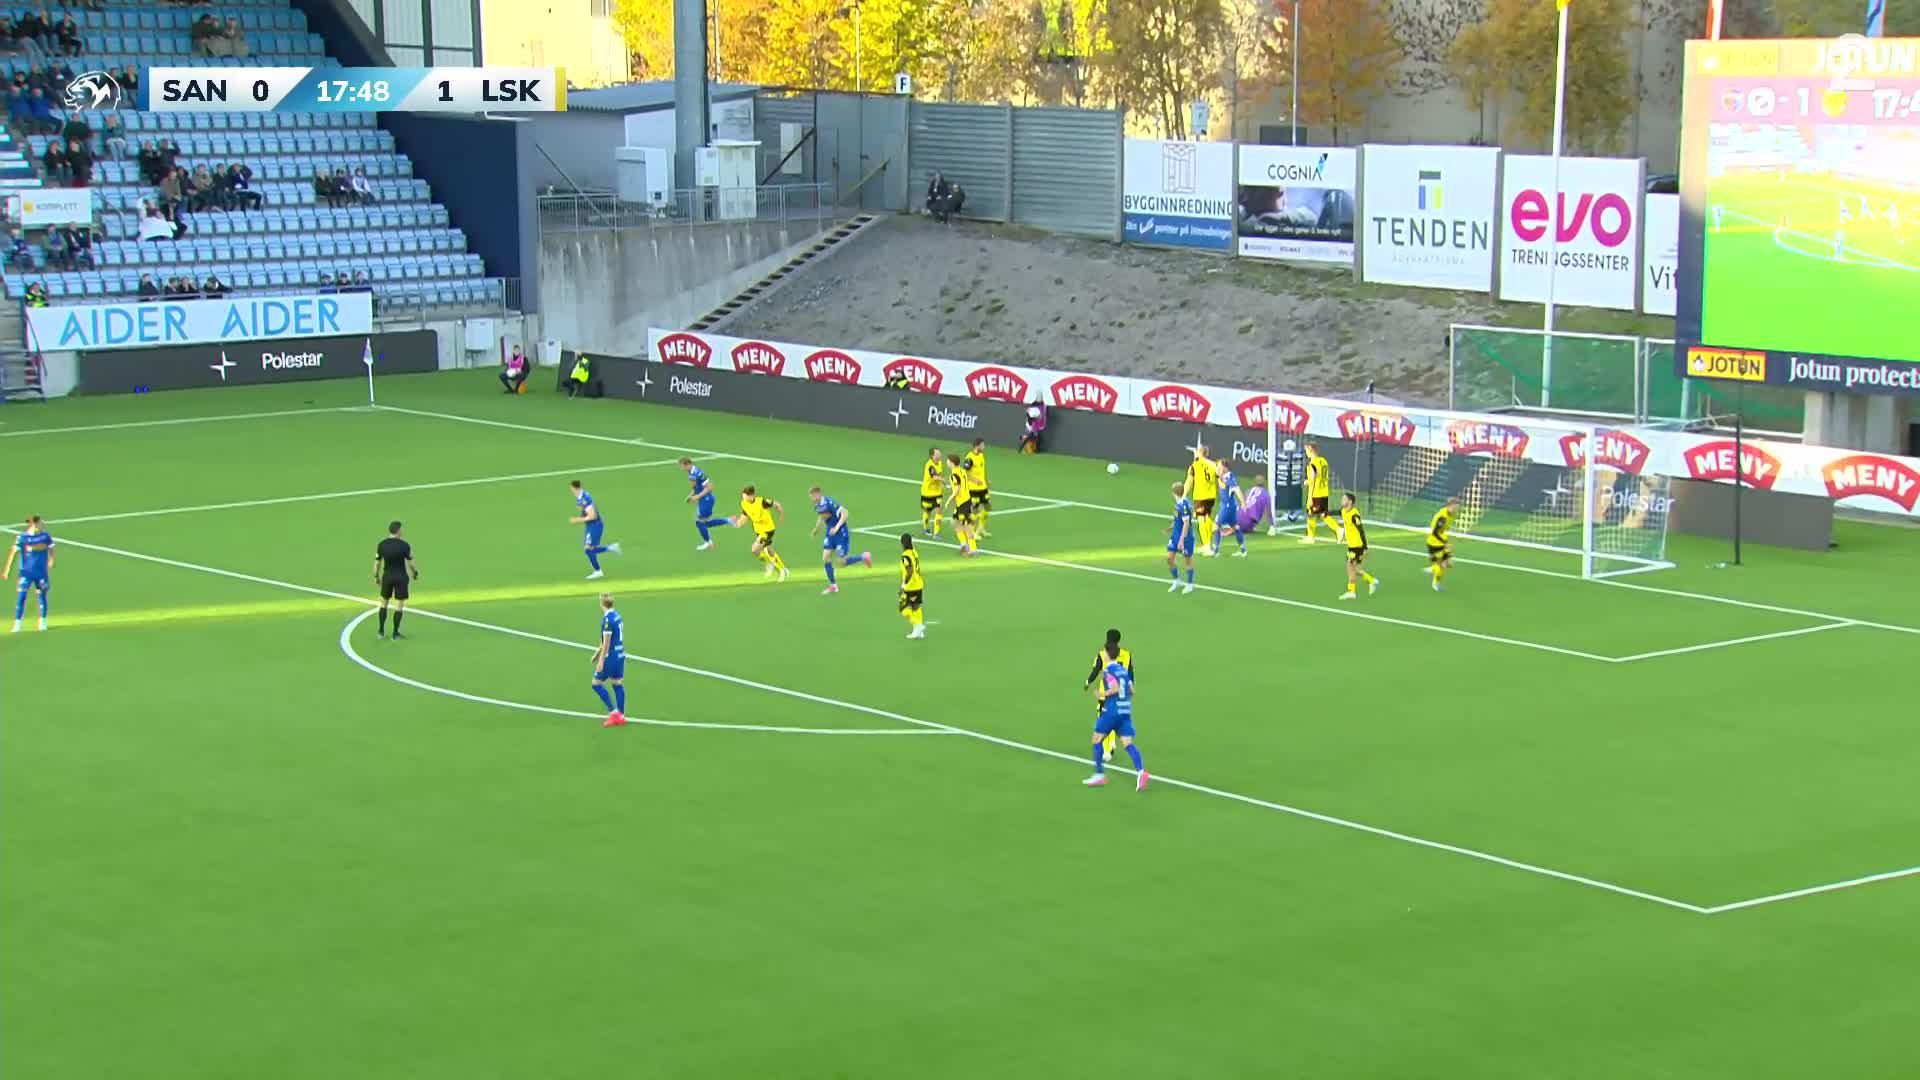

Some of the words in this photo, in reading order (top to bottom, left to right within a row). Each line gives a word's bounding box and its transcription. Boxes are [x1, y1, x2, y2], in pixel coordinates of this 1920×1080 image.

[1810, 44, 1914, 73] JOUN
[900, 77, 908, 91] F
[1796, 87, 1811, 117] 1
[1268, 159, 1326, 181] COGNIA
[1511, 189, 1632, 248] evo
[1372, 217, 1489, 250] TENDEN
[59, 305, 189, 346] AIDER
[220, 299, 341, 338] AIDER
[262, 352, 323, 370] Polestar
[663, 340, 706, 363] MENY
[736, 348, 780, 371] MENY
[810, 357, 856, 380] MENY
[890, 367, 937, 388] ENY
[1707, 356, 1760, 376] JOTUN
[1789, 357, 1841, 383] Jotun
[1846, 366, 1920, 388] protect
[670, 376, 712, 397] Polestar
[972, 374, 1022, 399] MENY
[1058, 383, 1113, 406] MENY
[928, 405, 978, 429] Polestar
[1151, 393, 1204, 419] MENY
[1346, 416, 1408, 442] MENY
[1455, 425, 1521, 452] MENY
[1233, 441, 1270, 464] Poles
[1570, 437, 1641, 466] MENY
[1695, 451, 1772, 481] MENY
[1832, 465, 1916, 497] MENY
[1601, 486, 1676, 514] Polestar
